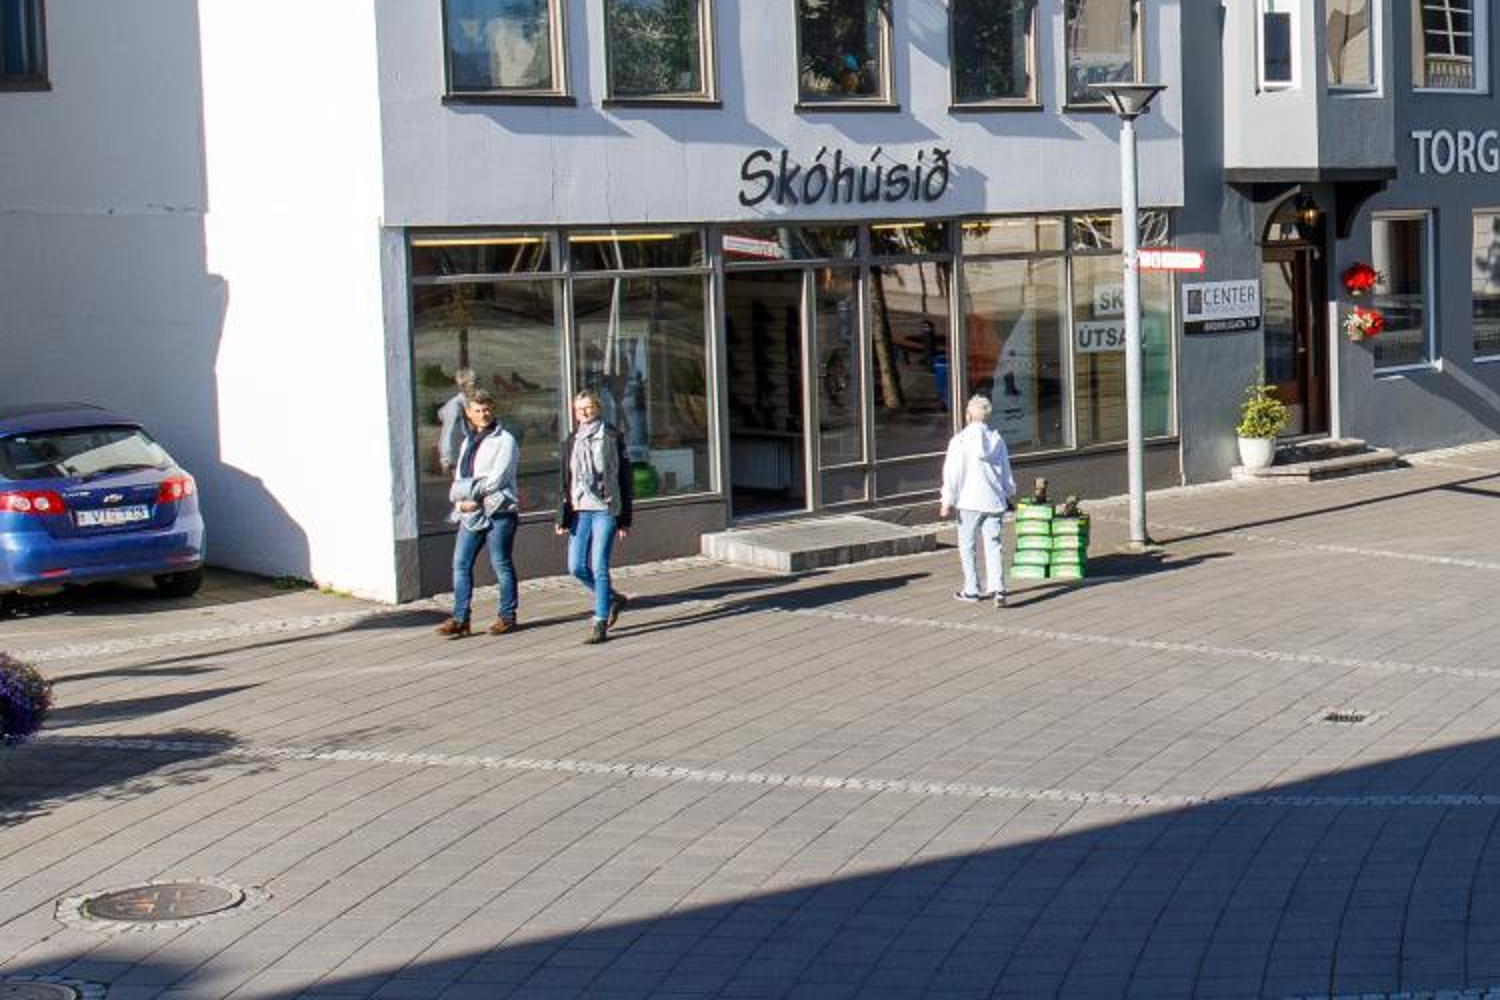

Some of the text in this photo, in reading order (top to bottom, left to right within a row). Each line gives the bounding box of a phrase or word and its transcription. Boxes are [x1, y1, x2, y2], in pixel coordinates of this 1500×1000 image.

[1411, 130, 1500, 174] TORG
[738, 146, 951, 207] Skóhúsið
[1203, 285, 1255, 305] CENTER
